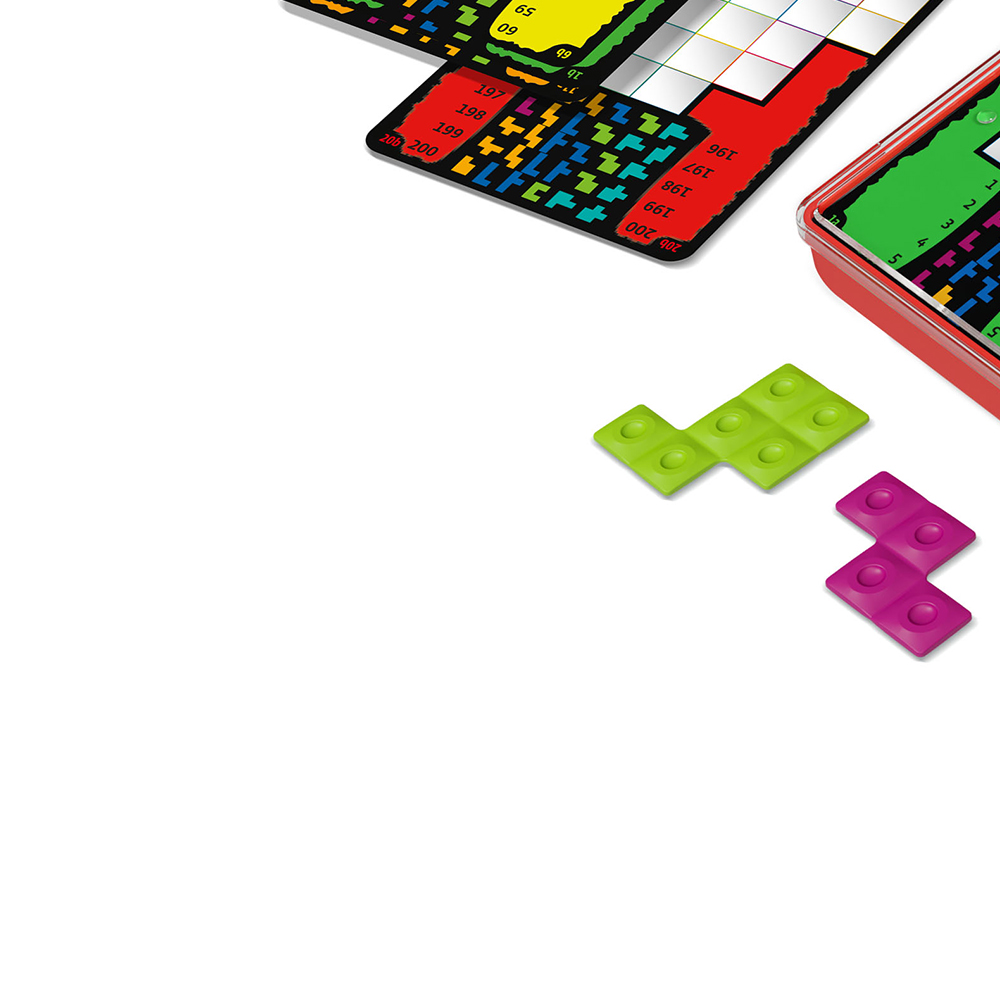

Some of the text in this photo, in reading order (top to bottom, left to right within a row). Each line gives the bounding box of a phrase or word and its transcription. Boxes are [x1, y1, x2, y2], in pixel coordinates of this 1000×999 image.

[514, 4, 536, 17] 59
[497, 23, 518, 35] 60
[556, 48, 572, 59] 6b
[567, 69, 583, 80] 1b
[473, 84, 506, 99] 197
[455, 103, 487, 120] 198
[432, 122, 464, 138] 199
[379, 133, 402, 147] 20b
[407, 140, 439, 156] 200
[706, 144, 738, 161] 196
[682, 163, 715, 179] 197
[661, 181, 693, 198] 198
[985, 179, 998, 190] 1
[643, 201, 676, 218] 199
[962, 198, 977, 210] 2
[625, 222, 657, 239] 200
[940, 218, 955, 229] 3
[660, 239, 682, 253] 20b
[917, 237, 929, 248] 4
[888, 253, 902, 264] 5
